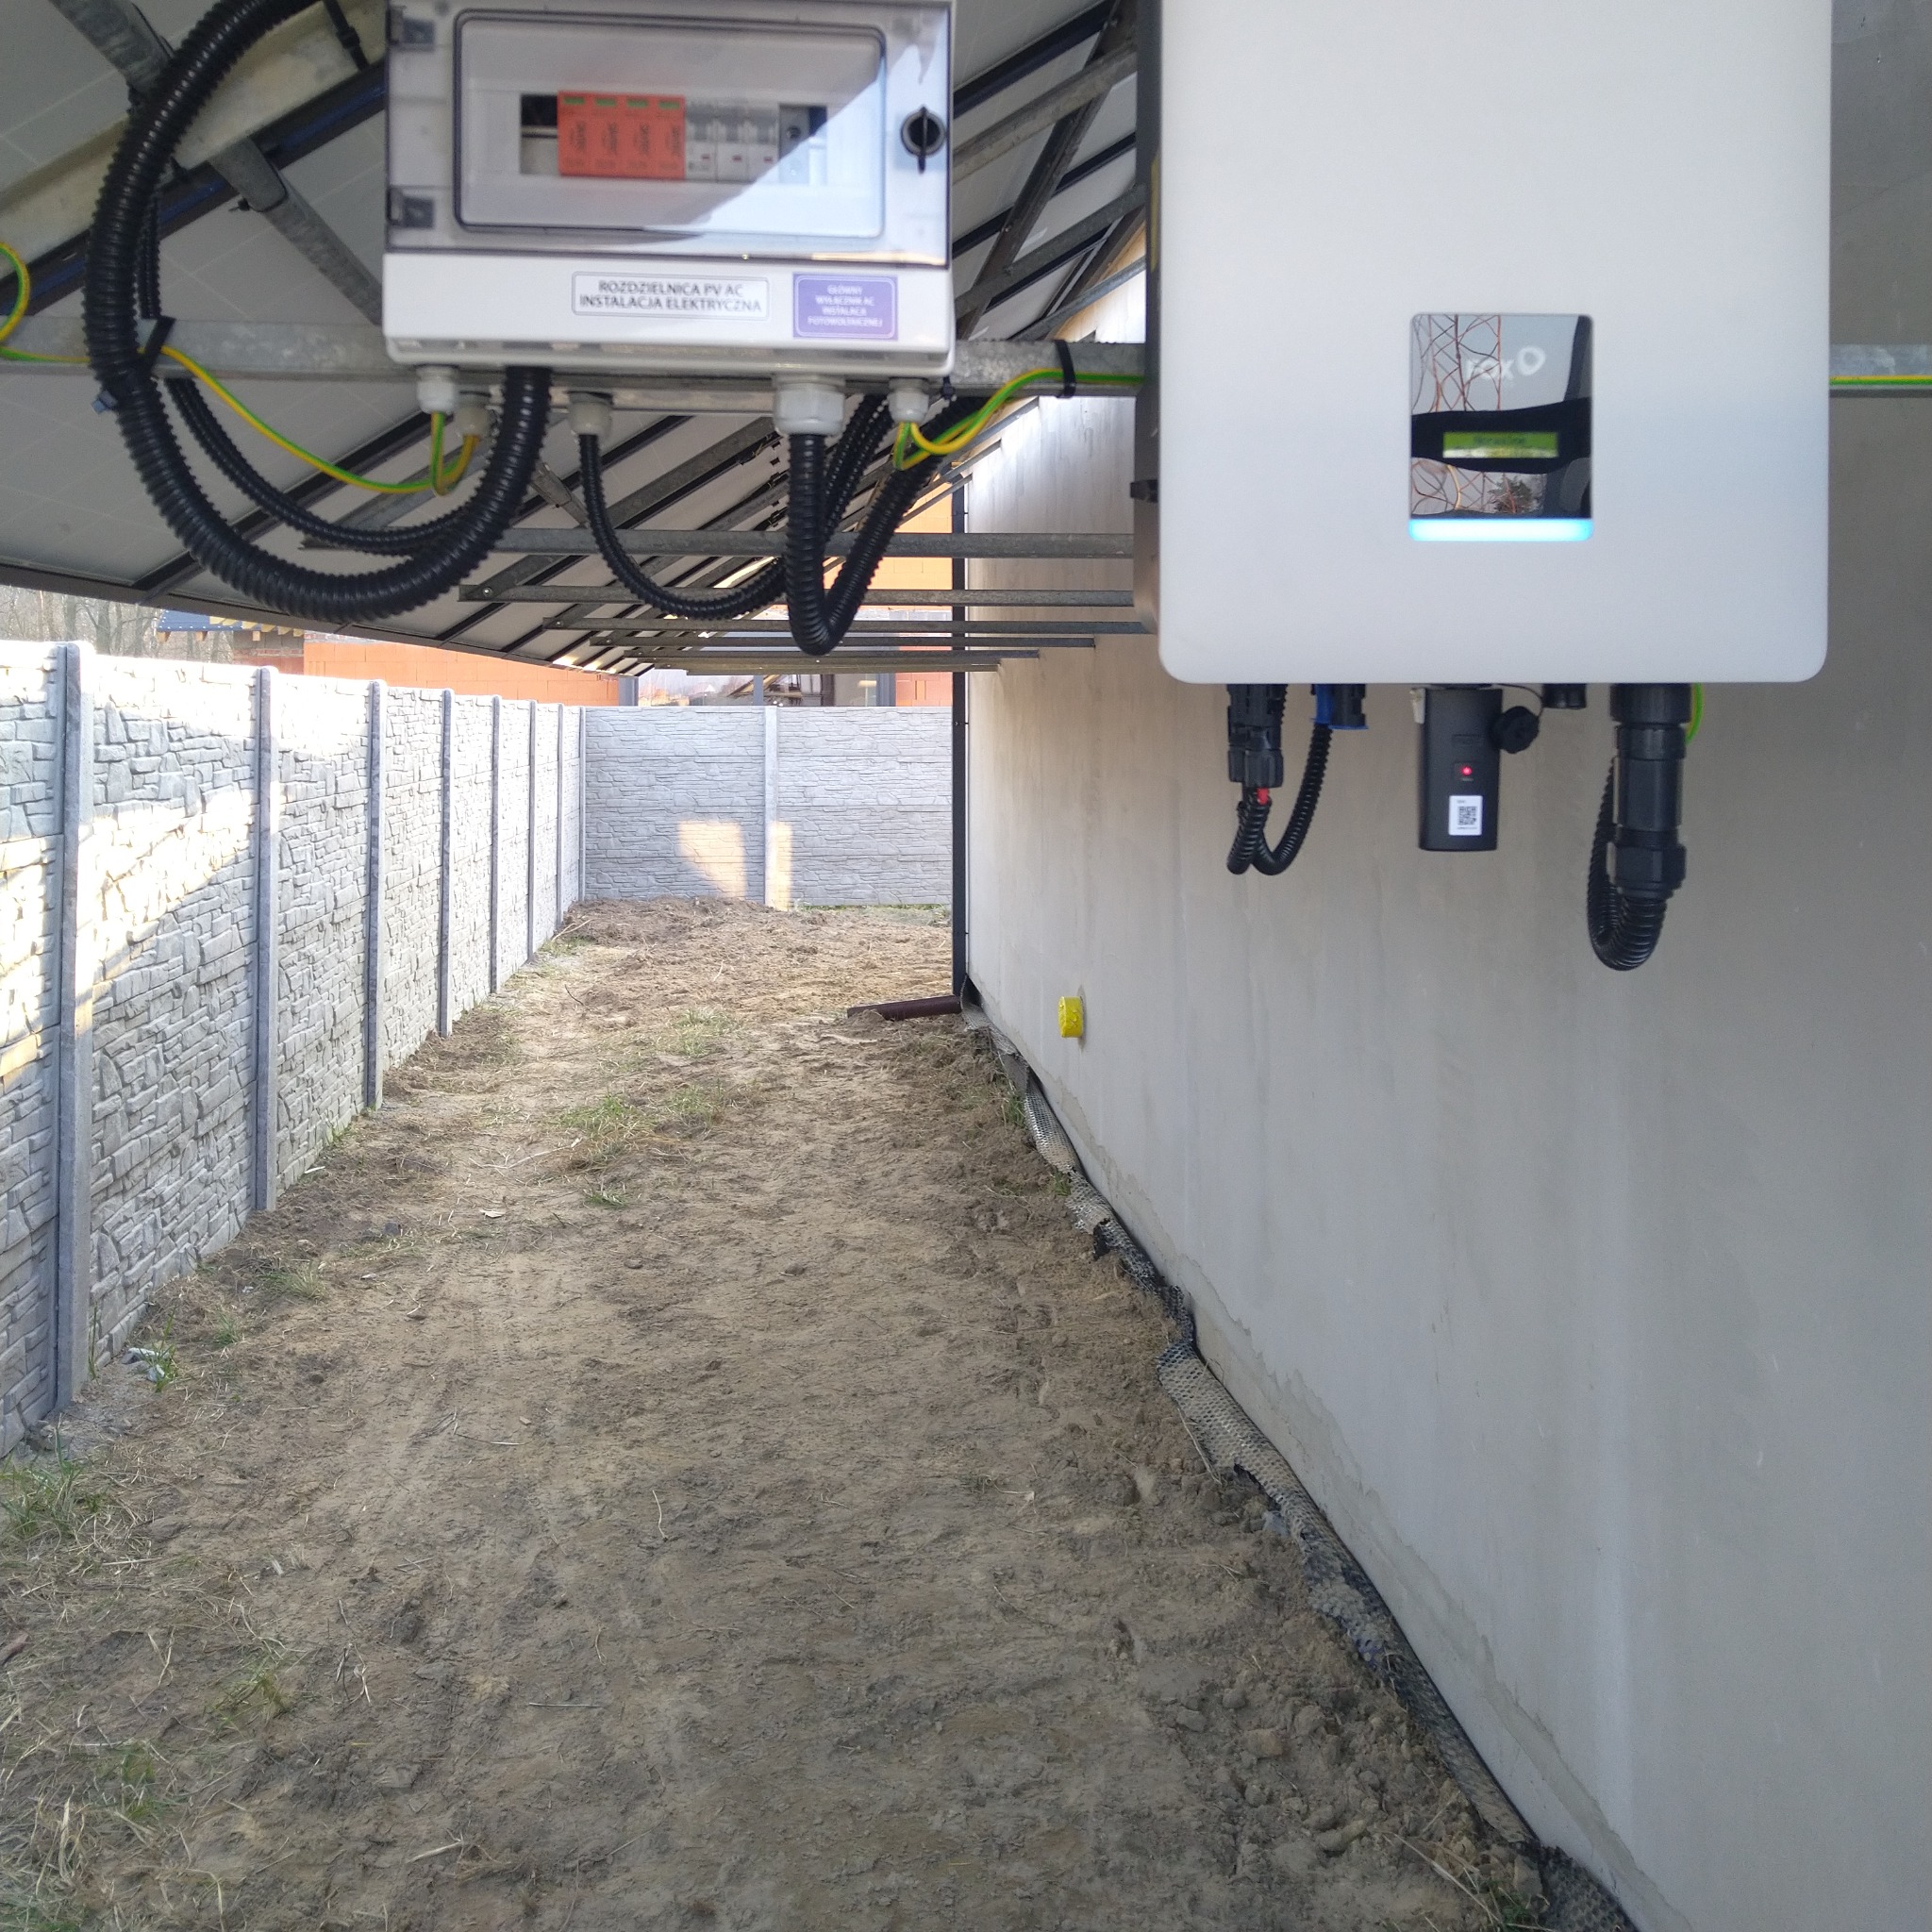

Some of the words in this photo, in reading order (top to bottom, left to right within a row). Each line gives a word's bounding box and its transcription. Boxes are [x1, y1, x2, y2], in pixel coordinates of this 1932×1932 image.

[598, 279, 700, 296] ROZDZIELNICA
[703, 282, 722, 297] PV
[724, 283, 744, 298] AC
[579, 293, 662, 310] INSTALACJA
[665, 296, 762, 313] ELEKTRYCZNA
